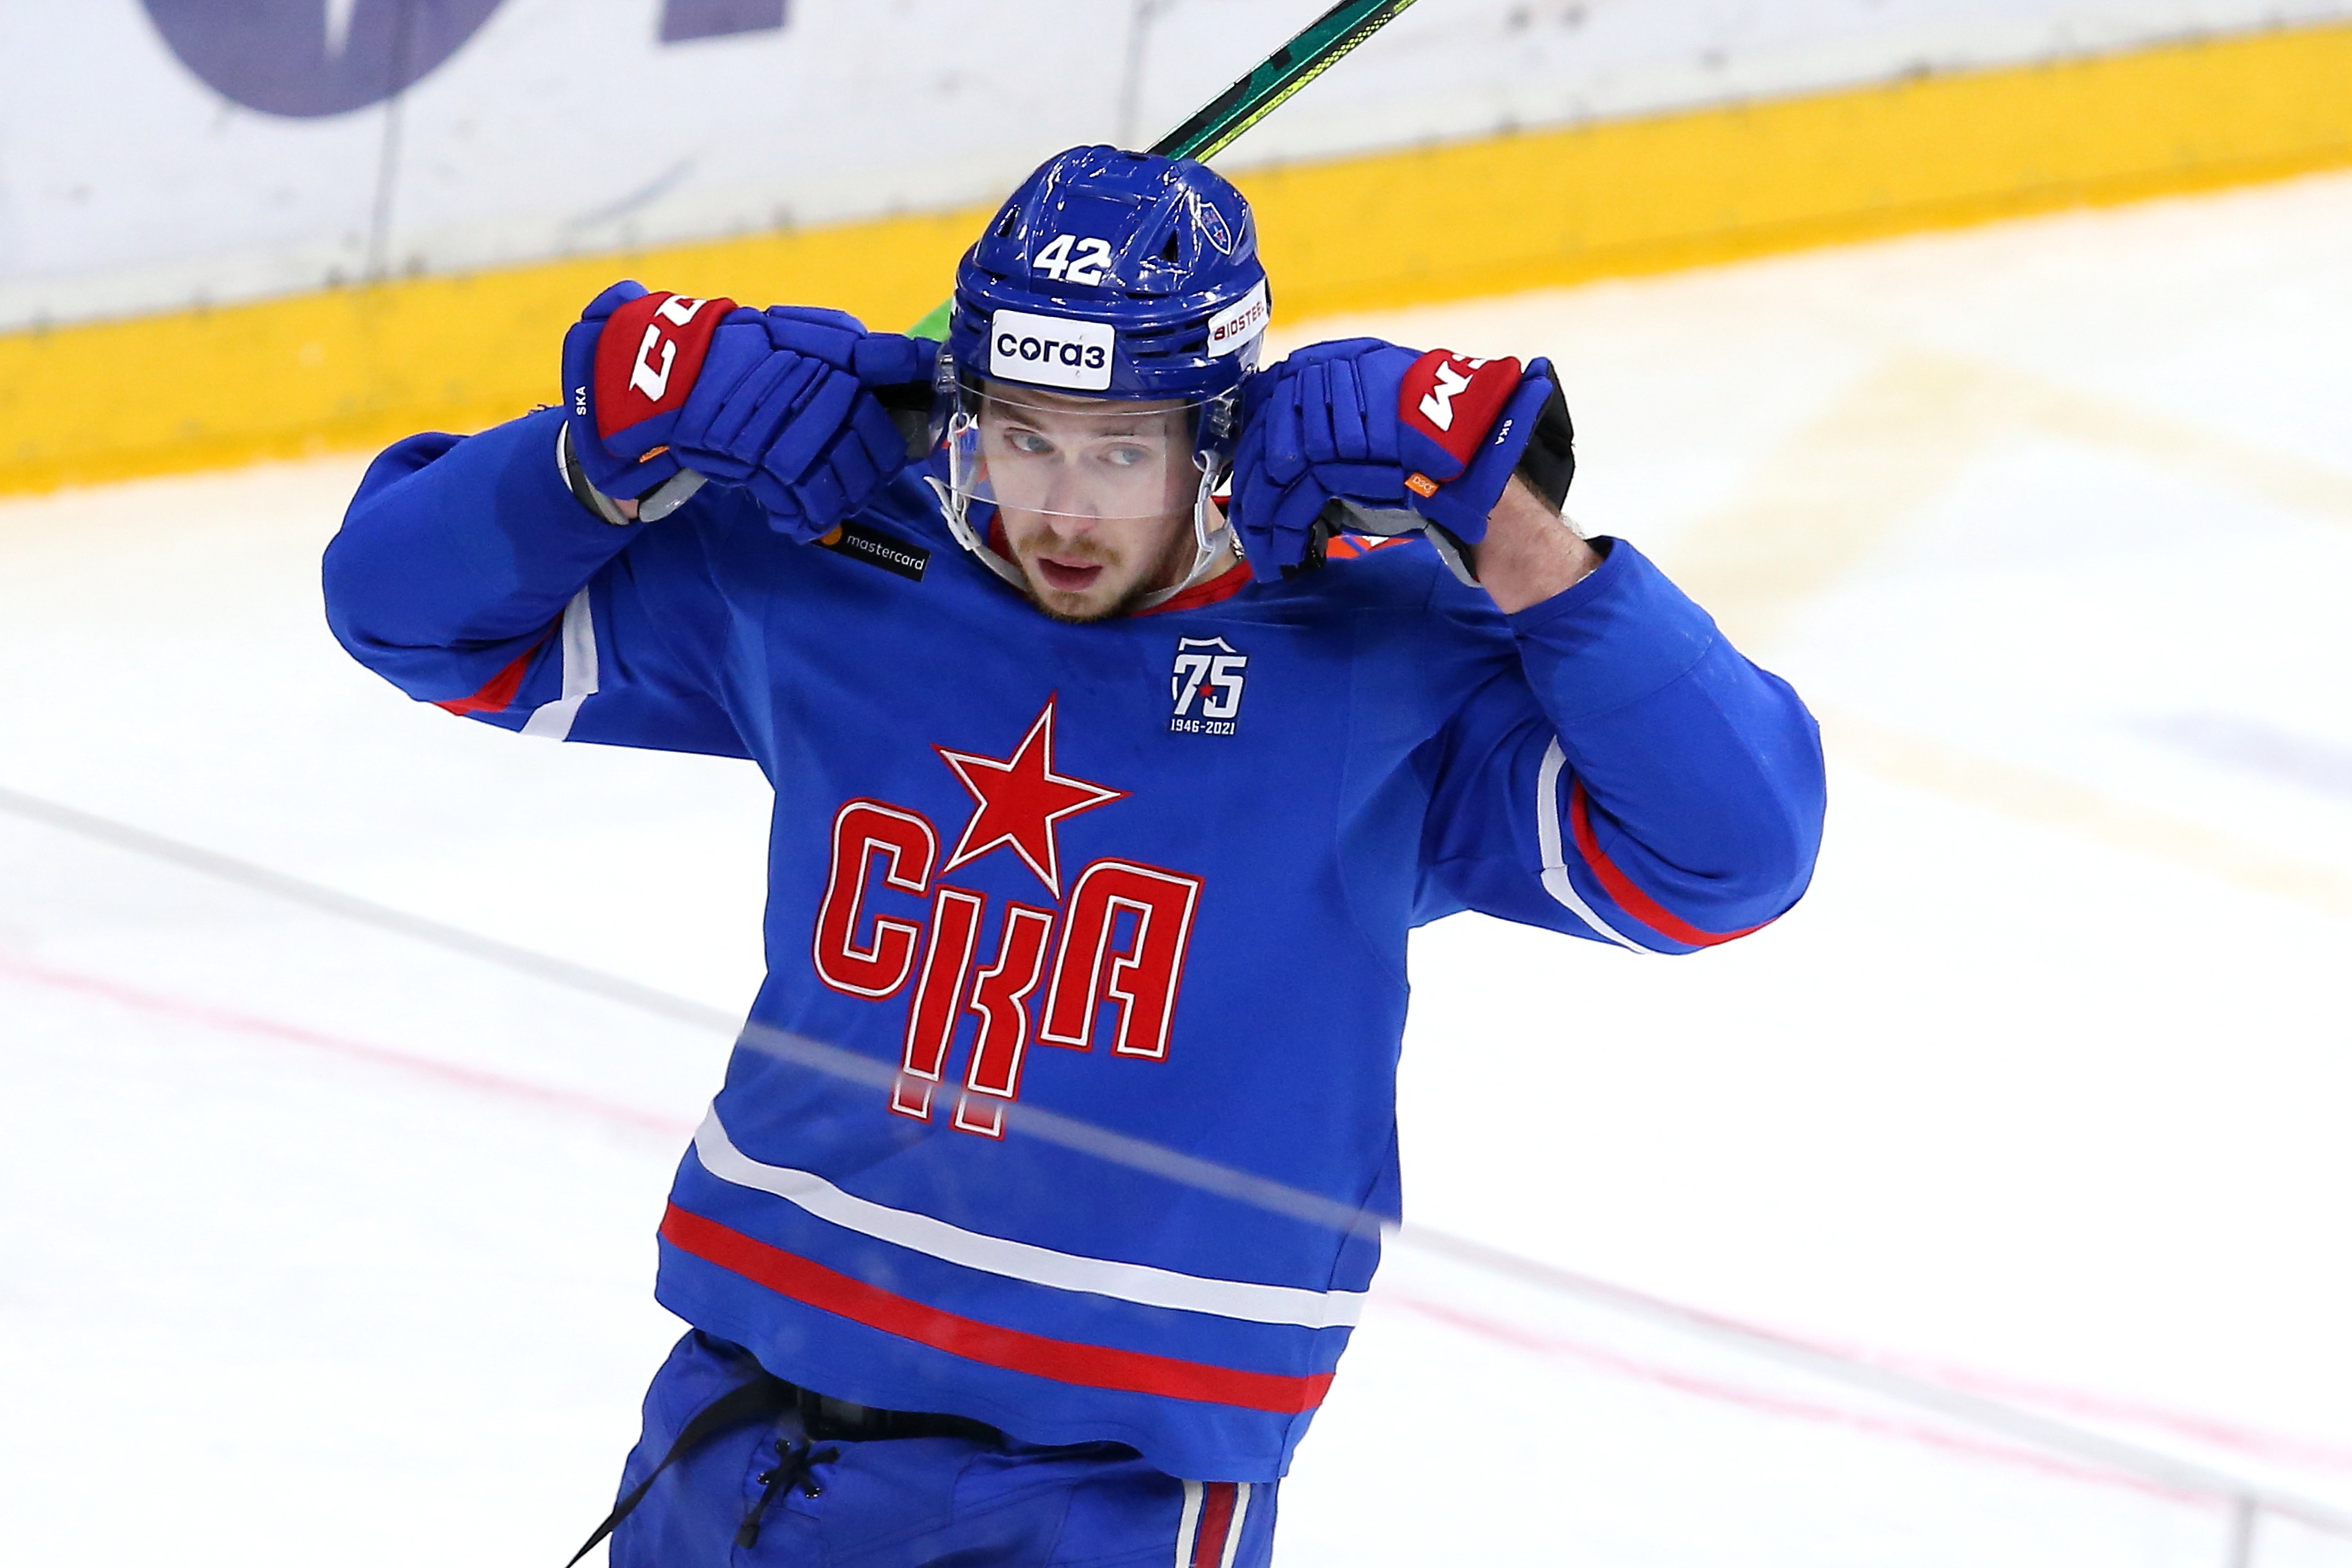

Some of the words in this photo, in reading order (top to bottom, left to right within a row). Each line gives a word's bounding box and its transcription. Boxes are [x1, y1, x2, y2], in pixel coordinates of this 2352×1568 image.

[1032, 233, 1112, 287] 42
[997, 333, 1105, 369] согаз
[574, 386, 587, 416] SKA
[1495, 419, 1513, 445] SKA
[846, 534, 925, 570] mastercard
[1173, 654, 1248, 718] 75
[1171, 718, 1236, 735] 1946-2021
[812, 797, 1204, 1141] СКА
